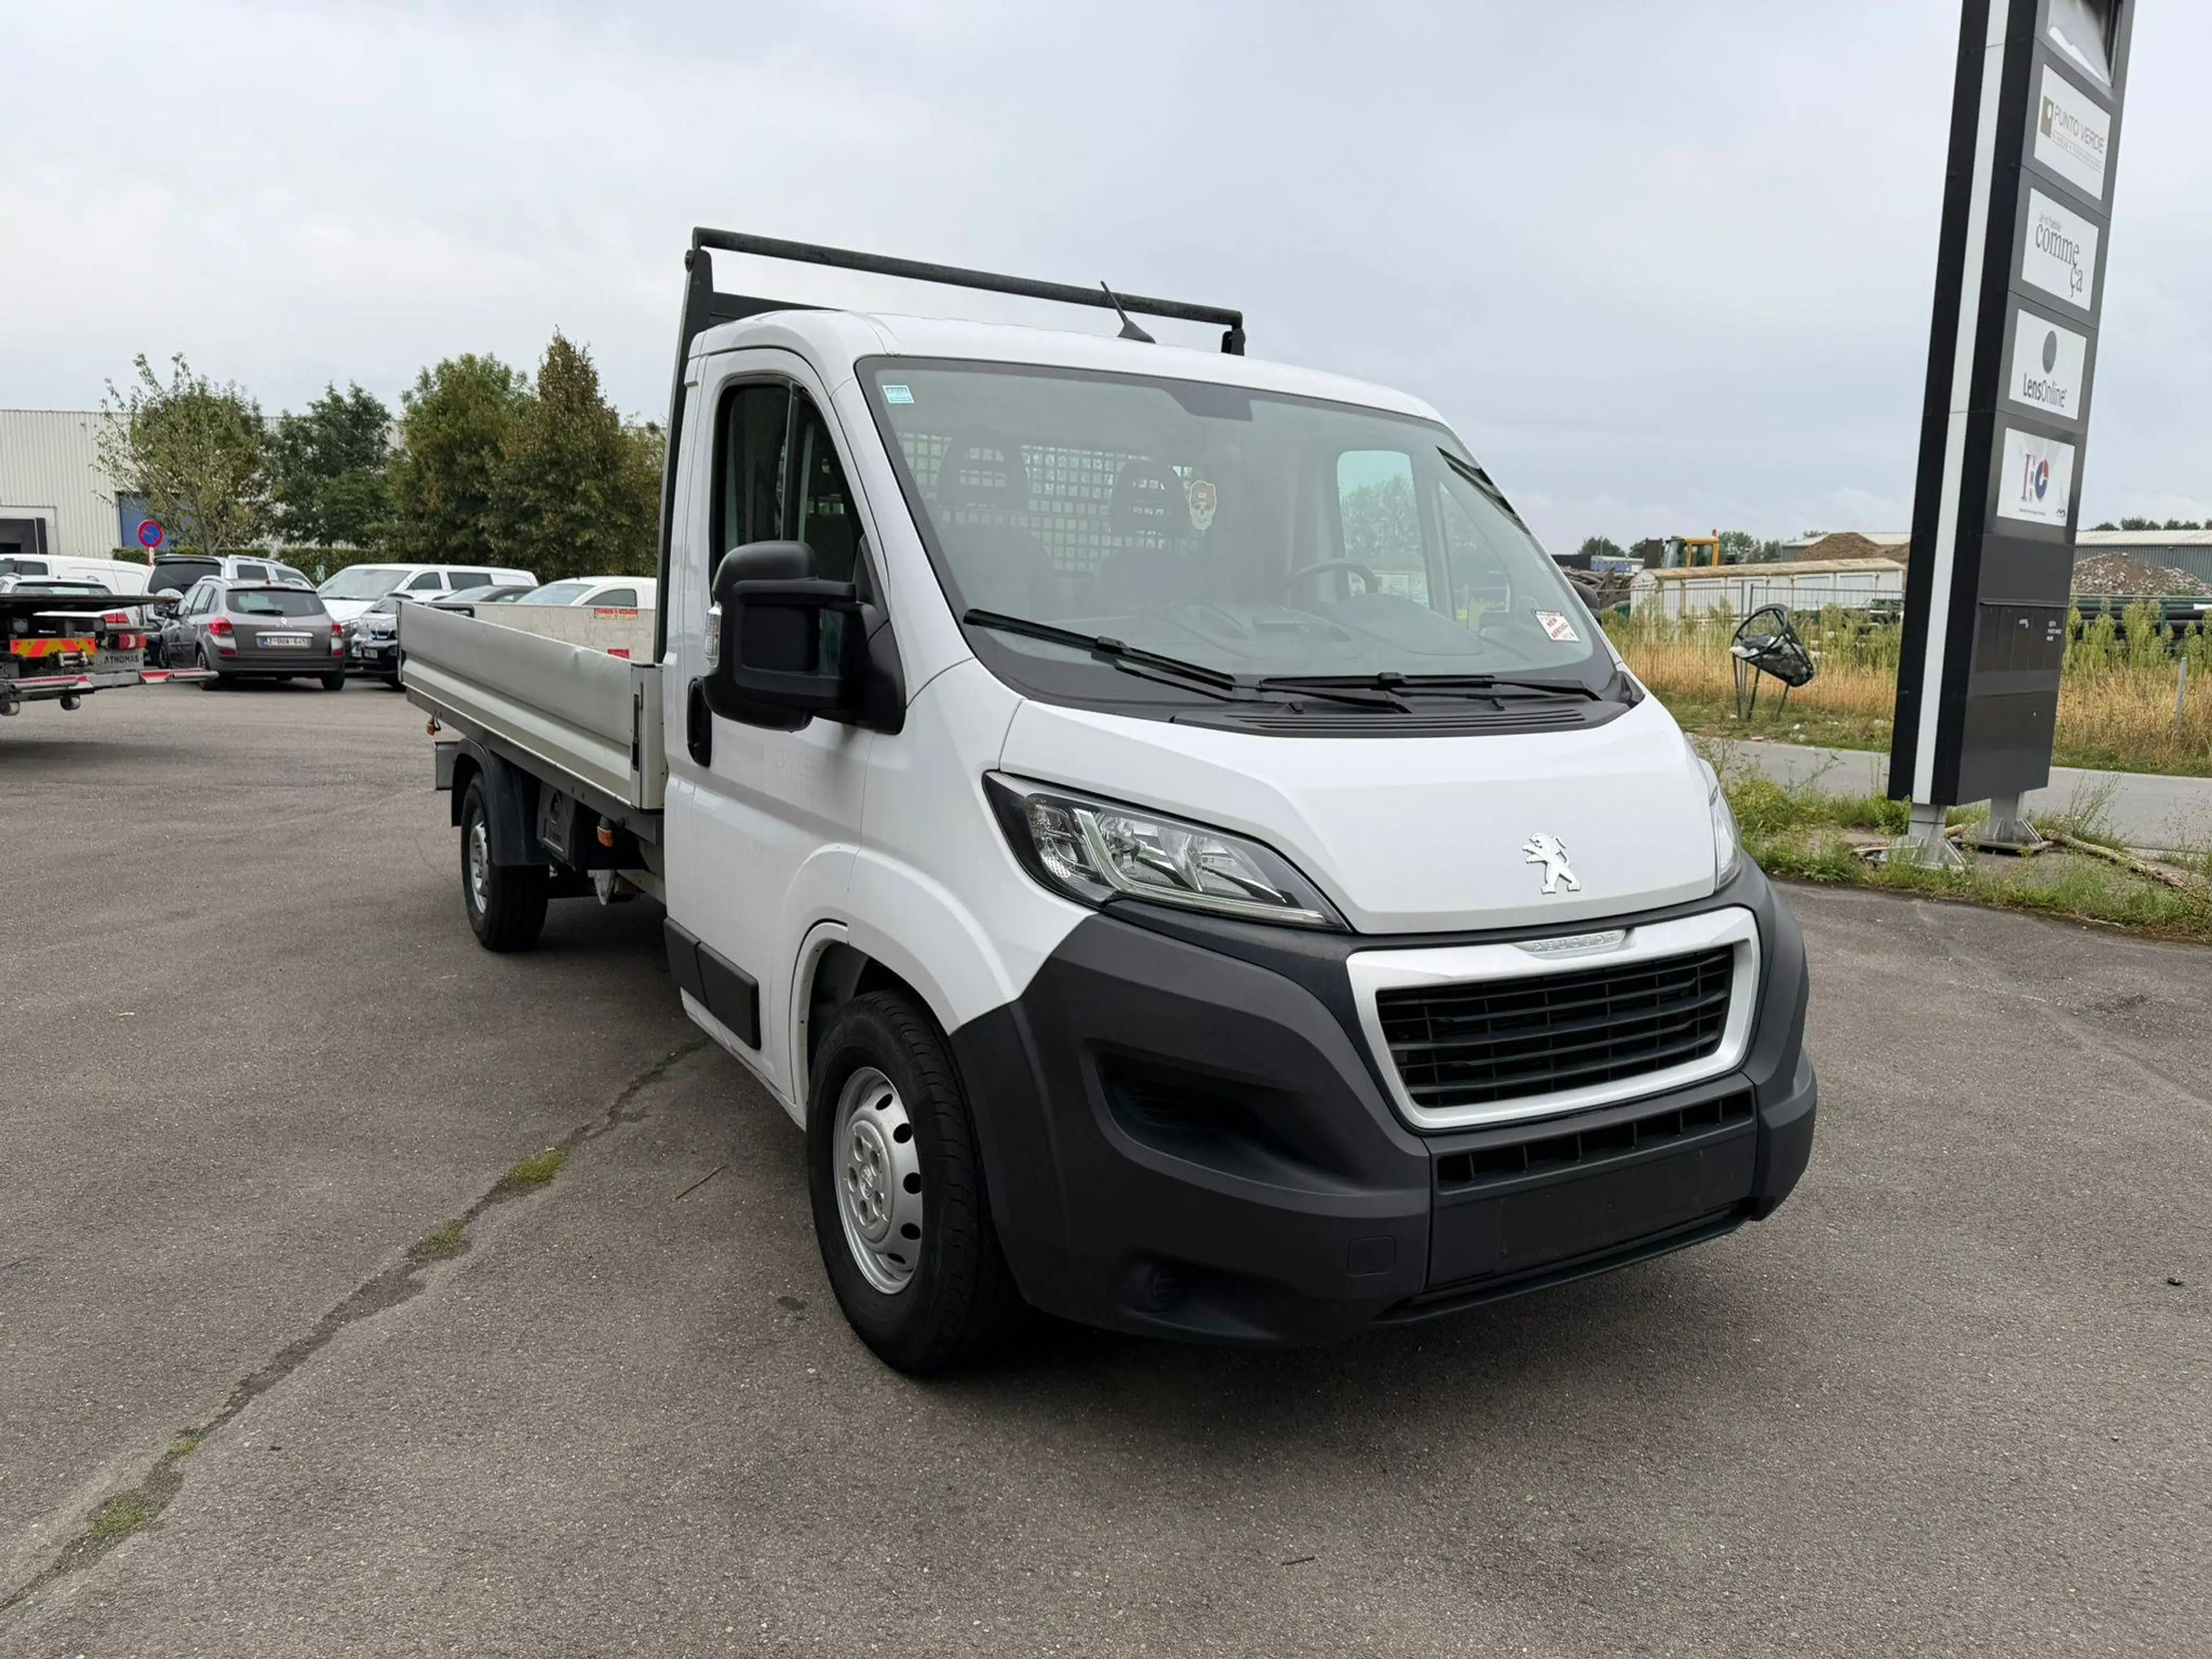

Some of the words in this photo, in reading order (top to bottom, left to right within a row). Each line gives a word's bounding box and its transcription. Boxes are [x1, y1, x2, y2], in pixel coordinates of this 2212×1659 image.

[2054, 105, 2080, 137] PUNTO
[2080, 124, 2104, 154] VERDE
[2036, 224, 2080, 266] comme
[2070, 266, 2083, 297] ça
[2023, 372, 2066, 408] LensOnline
[1532, 932, 1615, 952] PEUGEOT
